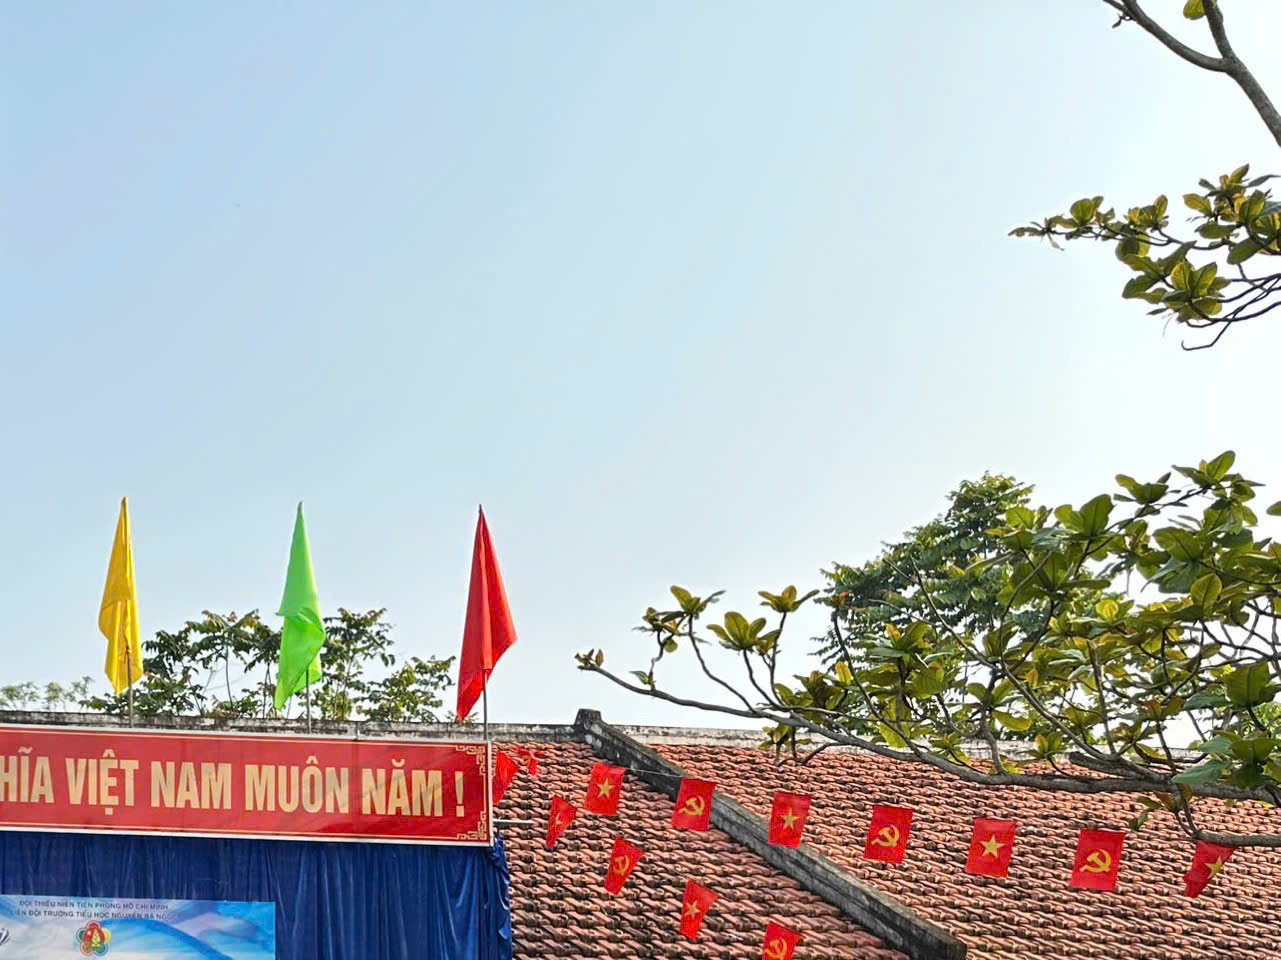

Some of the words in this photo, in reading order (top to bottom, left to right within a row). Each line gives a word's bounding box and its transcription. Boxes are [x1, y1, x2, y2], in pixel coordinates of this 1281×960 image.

[65, 749, 139, 815] VIỆT
[150, 761, 232, 810] NAM
[245, 754, 349, 814] MUÔN
[361, 758, 443, 817] NĂM
